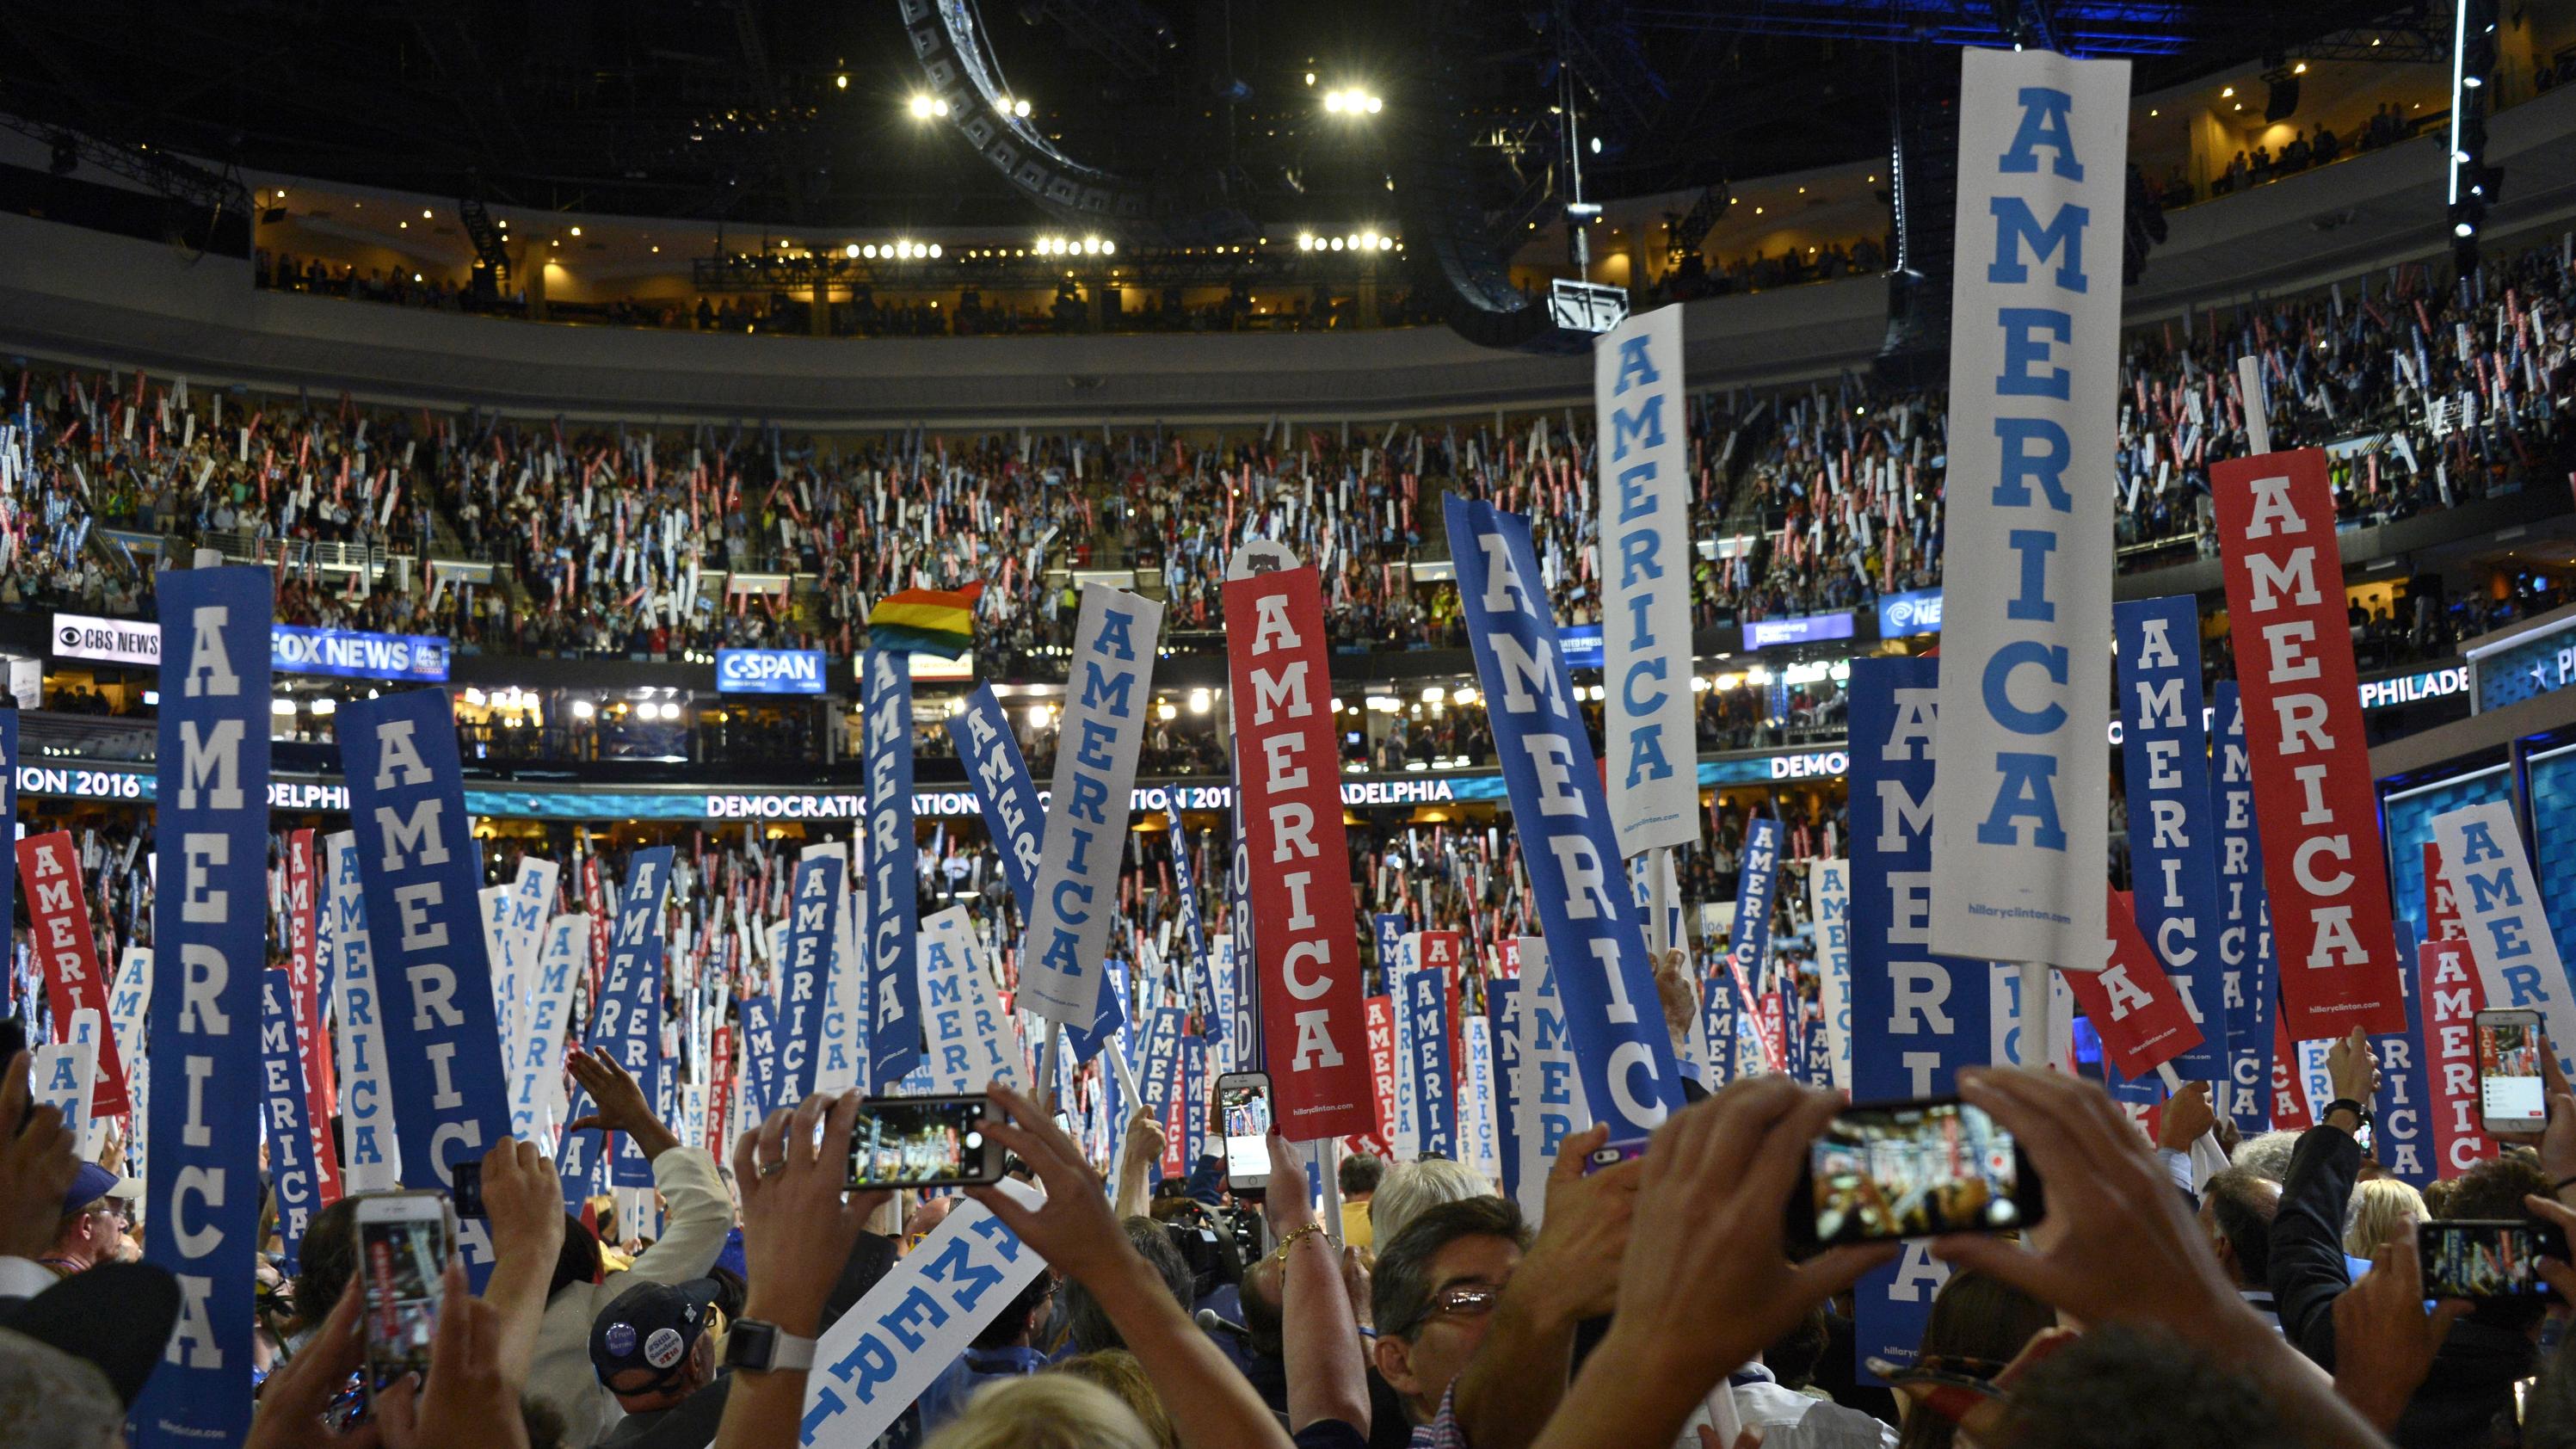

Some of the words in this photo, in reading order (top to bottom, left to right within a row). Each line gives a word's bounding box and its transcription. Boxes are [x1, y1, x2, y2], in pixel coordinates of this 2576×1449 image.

[1977, 87, 2089, 851] AMERICA
[85, 629, 114, 652] CBS
[118, 632, 158, 655] NEWS
[1612, 335, 1673, 790] AMERICA
[327, 637, 410, 671] NEWS
[724, 654, 816, 680] C-SPAN
[2244, 476, 2370, 969] AMERICA
[2360, 666, 2468, 707] PHILADE
[76, 772, 139, 798] 2016
[870, 651, 903, 1033] AMERICA
[967, 707, 1041, 881] AMER
[1041, 608, 1135, 977] AMERICA
[1192, 787, 1231, 809] 201
[1250, 595, 1344, 1072] AMERICA
[1478, 533, 1667, 1129] AMERIC
[34, 846, 110, 1084] AMERIA
[166, 607, 245, 1369] AMERICA
[778, 868, 827, 1106] AMERICA
[1167, 796, 1212, 1014] AMERICA
[1235, 774, 1252, 1072] LORID
[1968, 903, 2071, 925] hillaryclinton.com
[2461, 821, 2557, 1049] AMER
[512, 927, 572, 1141] AMERIC
[927, 942, 970, 1093] AMERI
[1146, 1014, 1175, 1110] AMER
[1219, 945, 1234, 1064] AMERI
[1367, 1004, 1396, 1143] AMERIC
[1417, 979, 1446, 1155] AMERIC
[1708, 987, 1731, 1086] AMER
[1877, 688, 1954, 1301] AMERIA
[2309, 1001, 2380, 1014] hillaryclinton.com
[2433, 952, 2481, 1170] AMERIC
[706, 1035, 727, 1158] AMERI
[1188, 1046, 1203, 1162] AMER
[1293, 1103, 1353, 1117] hillaryclinton.com
[1472, 1024, 1493, 1158] AMERICA
[2382, 1039, 2423, 1174] RICA
[798, 1216, 1021, 1447] AMERI
